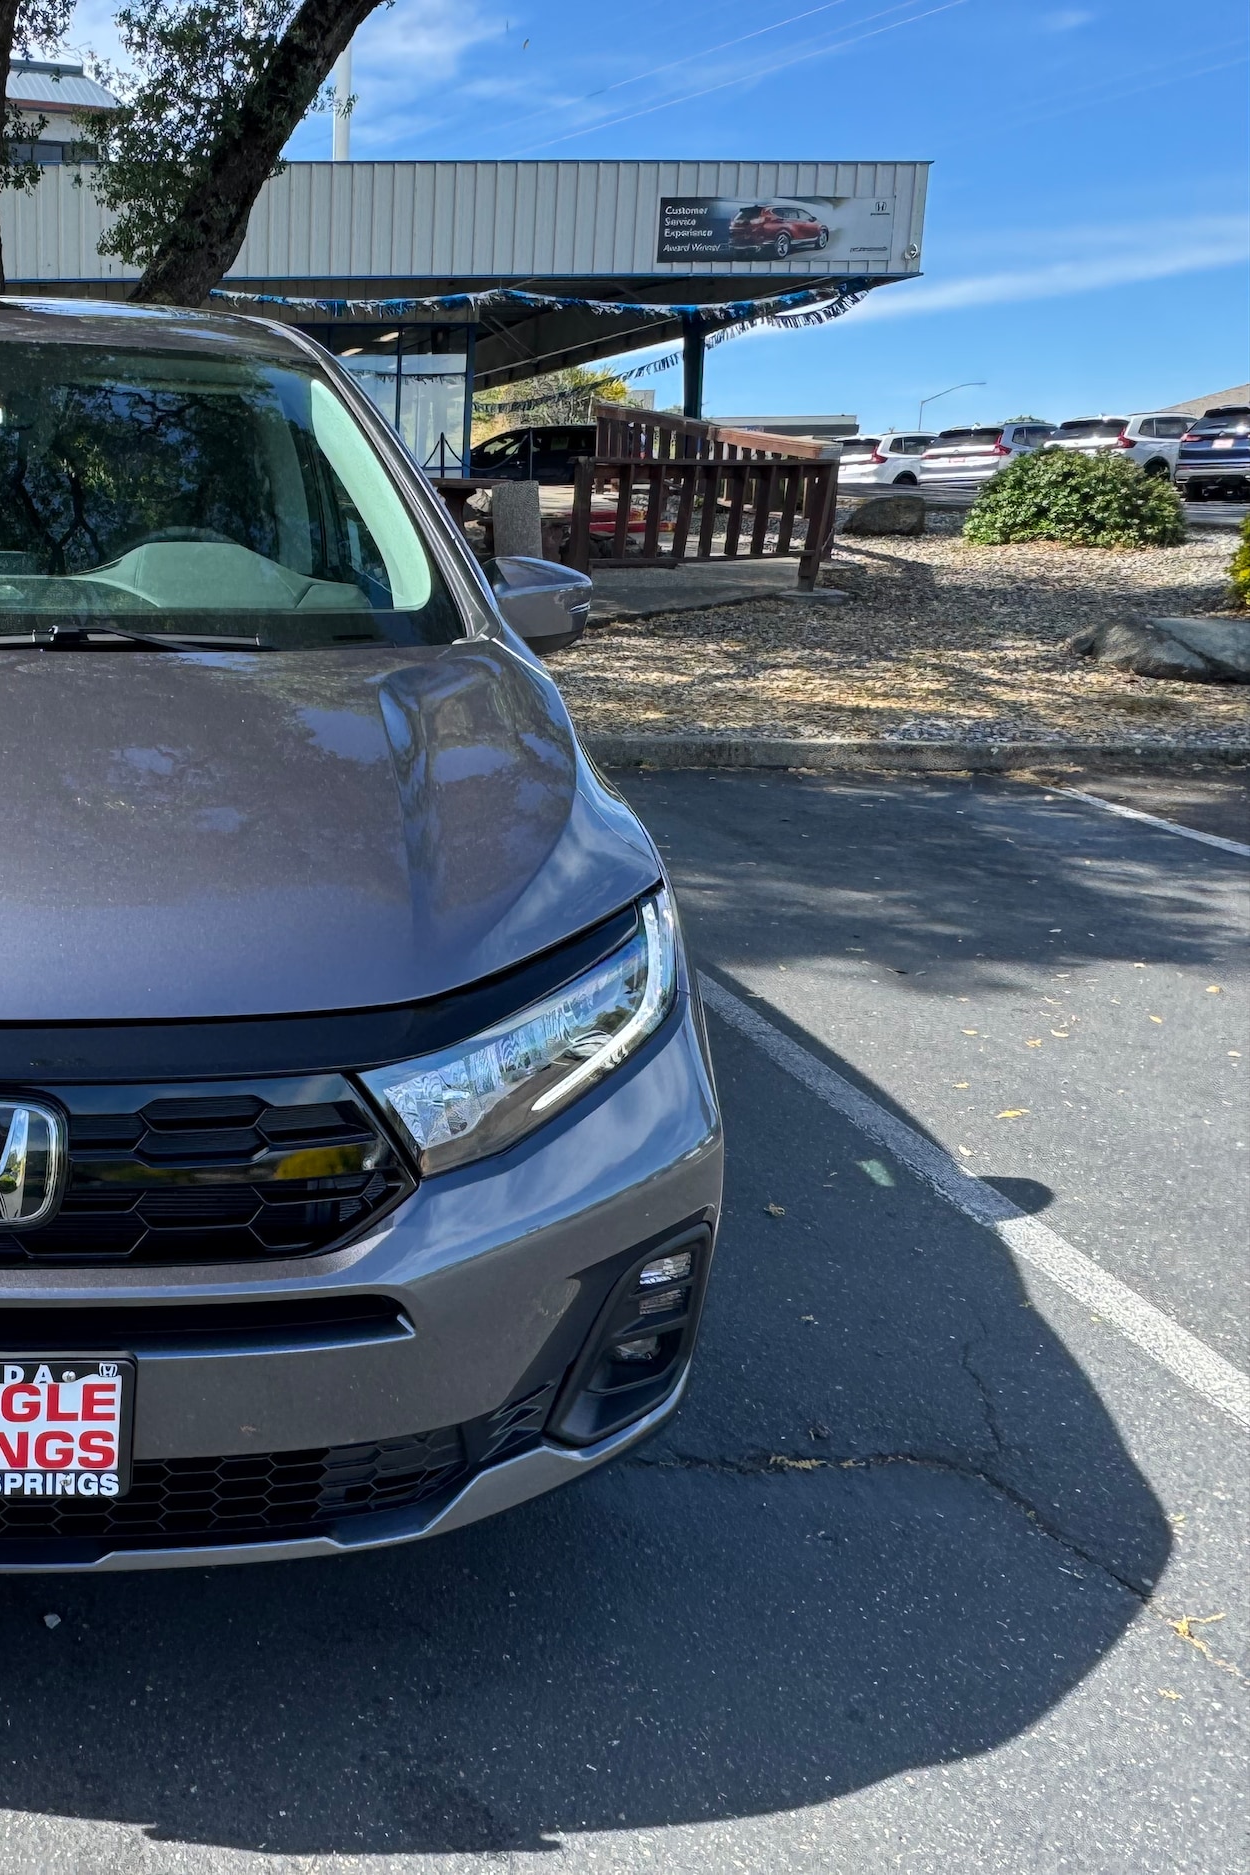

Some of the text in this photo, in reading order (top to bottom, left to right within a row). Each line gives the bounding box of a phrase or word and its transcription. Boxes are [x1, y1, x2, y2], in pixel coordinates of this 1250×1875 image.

[665, 205, 709, 215] Customer
[664, 217, 697, 227] Service
[664, 229, 713, 238] Experience
[663, 243, 690, 252] Award
